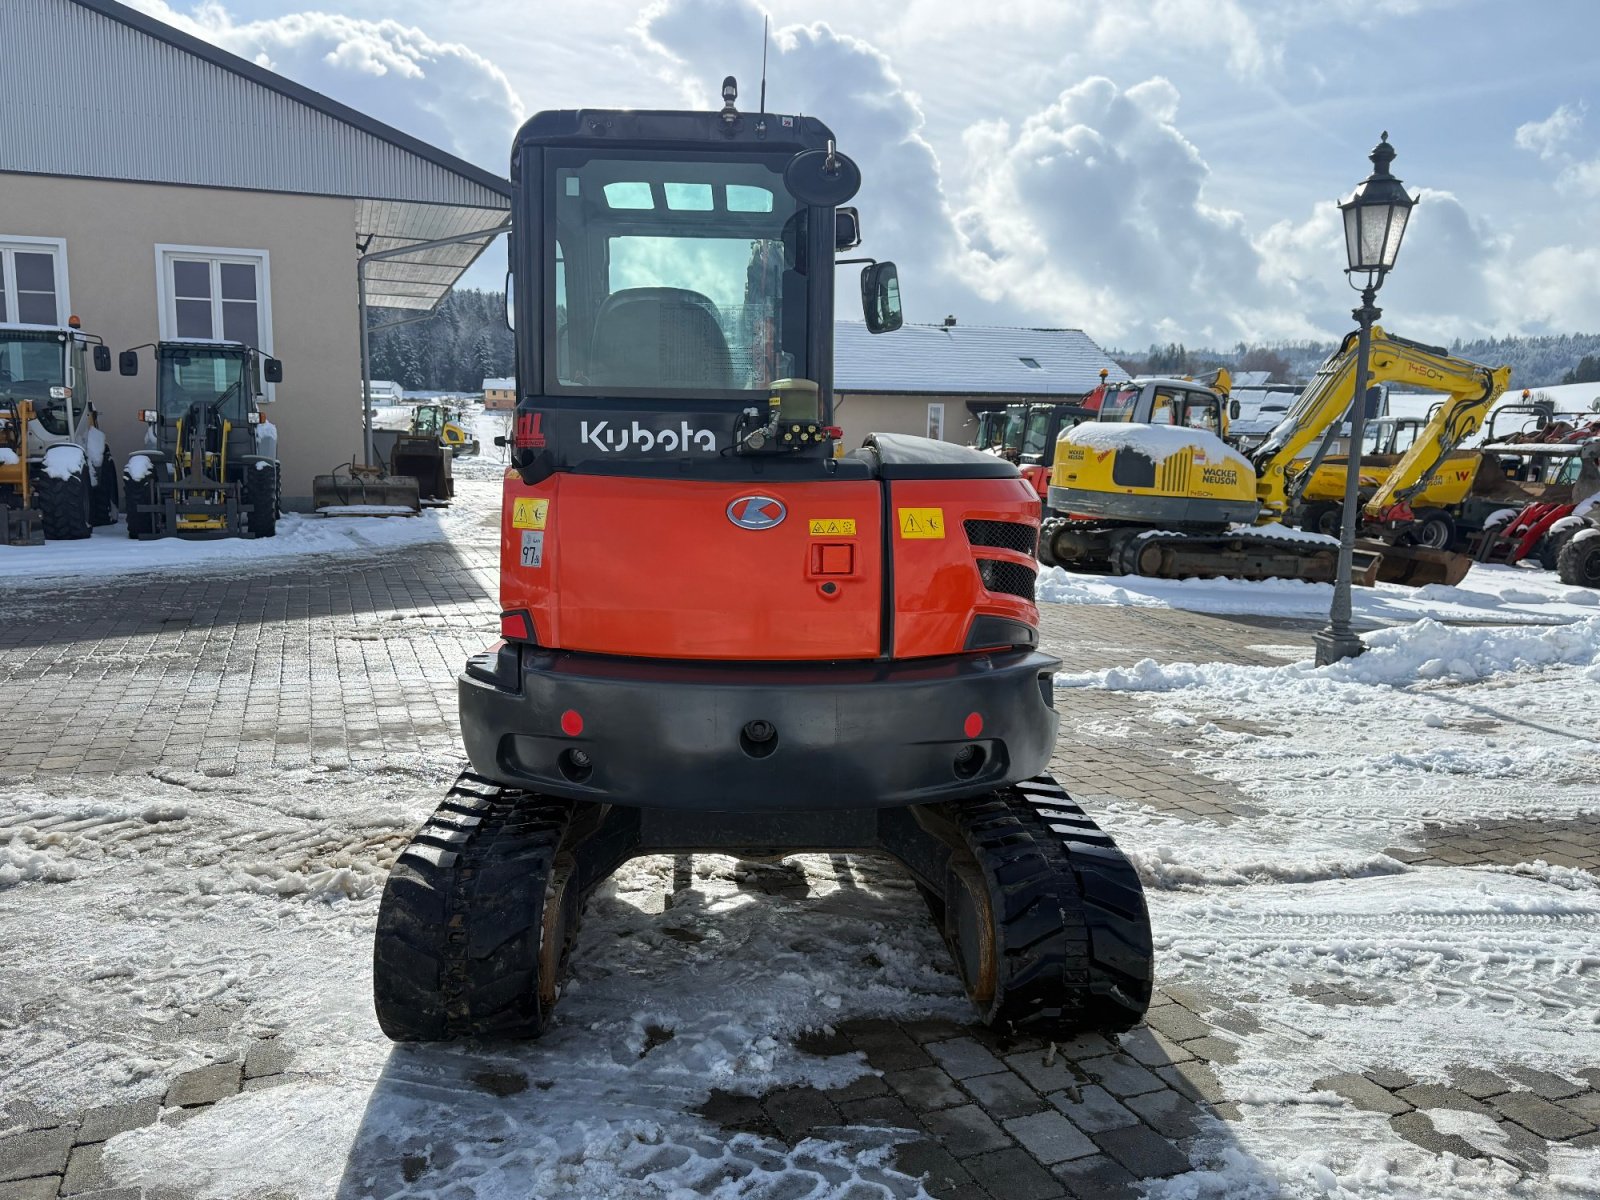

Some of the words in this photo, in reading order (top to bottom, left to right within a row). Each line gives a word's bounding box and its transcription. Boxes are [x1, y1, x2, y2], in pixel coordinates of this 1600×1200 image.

[580, 421, 716, 452] Kubota
[1202, 467, 1237, 478] WACKER
[1202, 475, 1237, 486] NEUSON
[521, 545, 536, 564] 97
